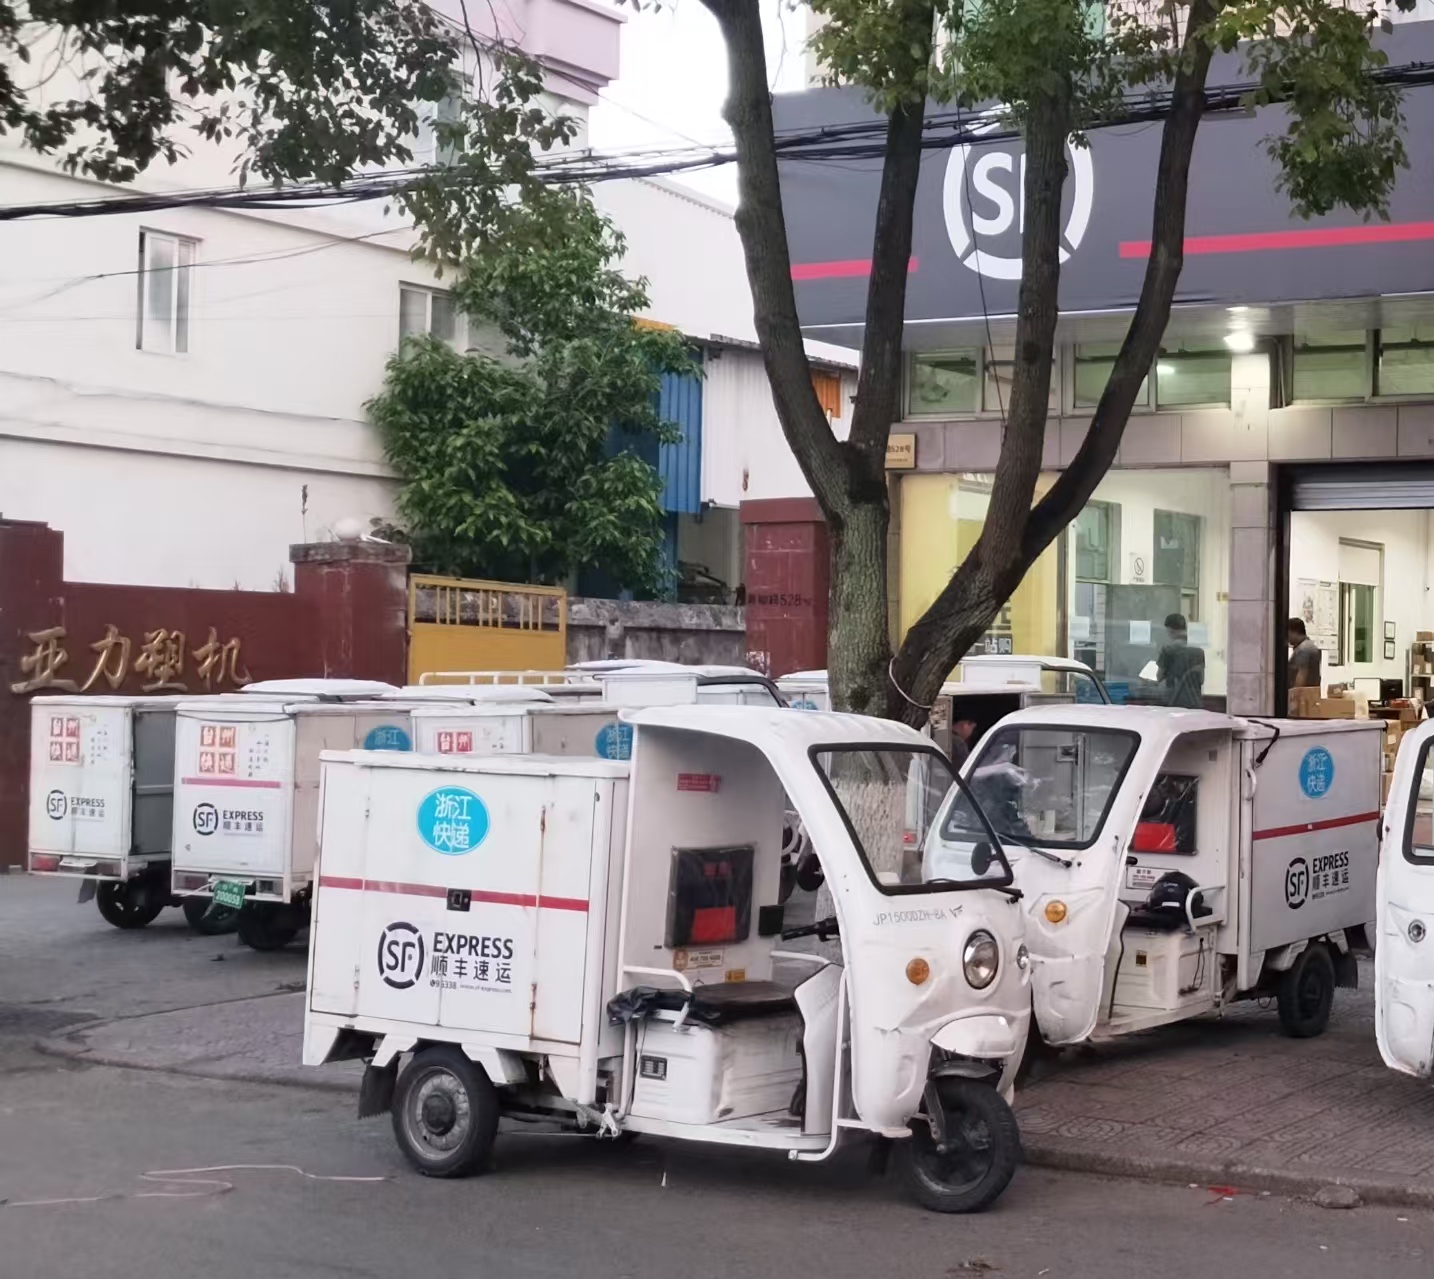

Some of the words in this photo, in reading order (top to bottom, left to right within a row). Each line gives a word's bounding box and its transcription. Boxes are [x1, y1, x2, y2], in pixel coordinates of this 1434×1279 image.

[11, 624, 253, 693] 亚力塑机
[374, 728, 402, 745] 浙江
[438, 731, 473, 752] 台州
[1307, 752, 1328, 772] 浙江
[71, 797, 105, 808] EXPRESS
[434, 792, 473, 820] 浙江
[222, 809, 264, 821] EXPRESS
[432, 820, 470, 850] 快递
[1312, 851, 1349, 874] EXPRESS
[432, 931, 514, 960] EXPRESS
[430, 954, 512, 984] 顺丰速运
